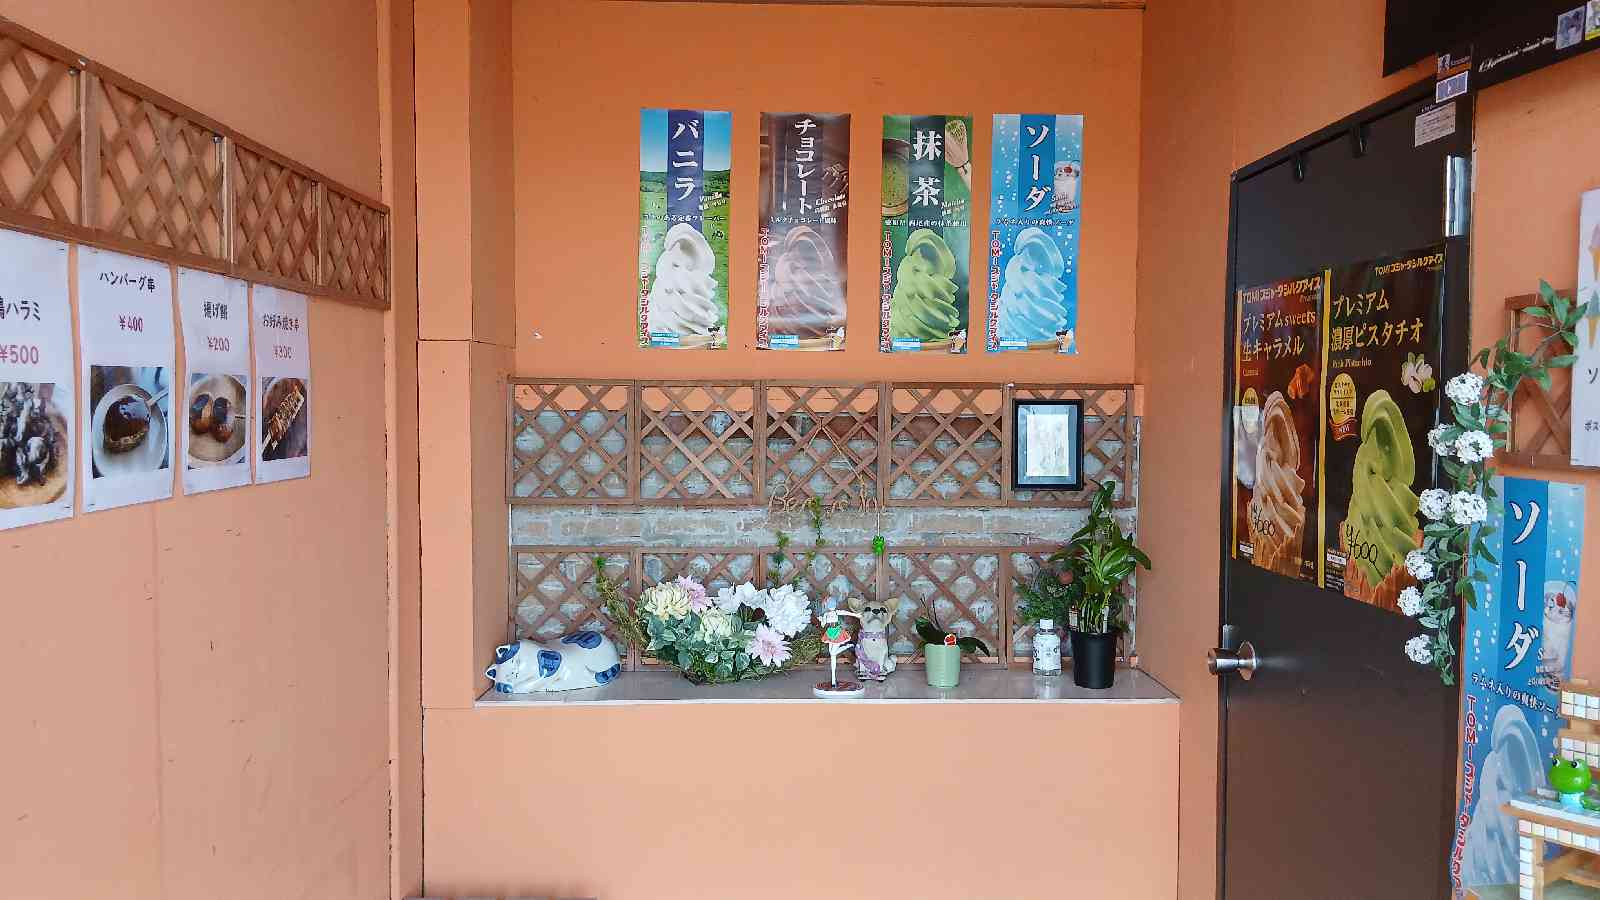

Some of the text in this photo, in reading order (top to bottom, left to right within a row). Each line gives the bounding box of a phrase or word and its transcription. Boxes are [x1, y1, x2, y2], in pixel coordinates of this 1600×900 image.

[671, 119, 700, 201] バニラ
[794, 118, 816, 214] チョコレート
[912, 130, 943, 207] 抹茶
[1024, 124, 1051, 212] ソーダ
[99, 271, 155, 292] ハンバーグ串
[1333, 288, 1390, 319] プレミアム
[119, 315, 144, 332] ¥400
[263, 313, 300, 333] お好み焼き串
[1331, 317, 1424, 352] 濃厚ピスタチオ
[0, 344, 39, 365] ¥500
[207, 336, 230, 353] ¥200
[273, 345, 293, 360] ¥300
[1242, 335, 1305, 362] 生キャラメル
[1585, 419, 1600, 432] ポス
[1505, 500, 1541, 670] ソーダ
[1472, 672, 1559, 719] ラムネ入りの爽快ソー
